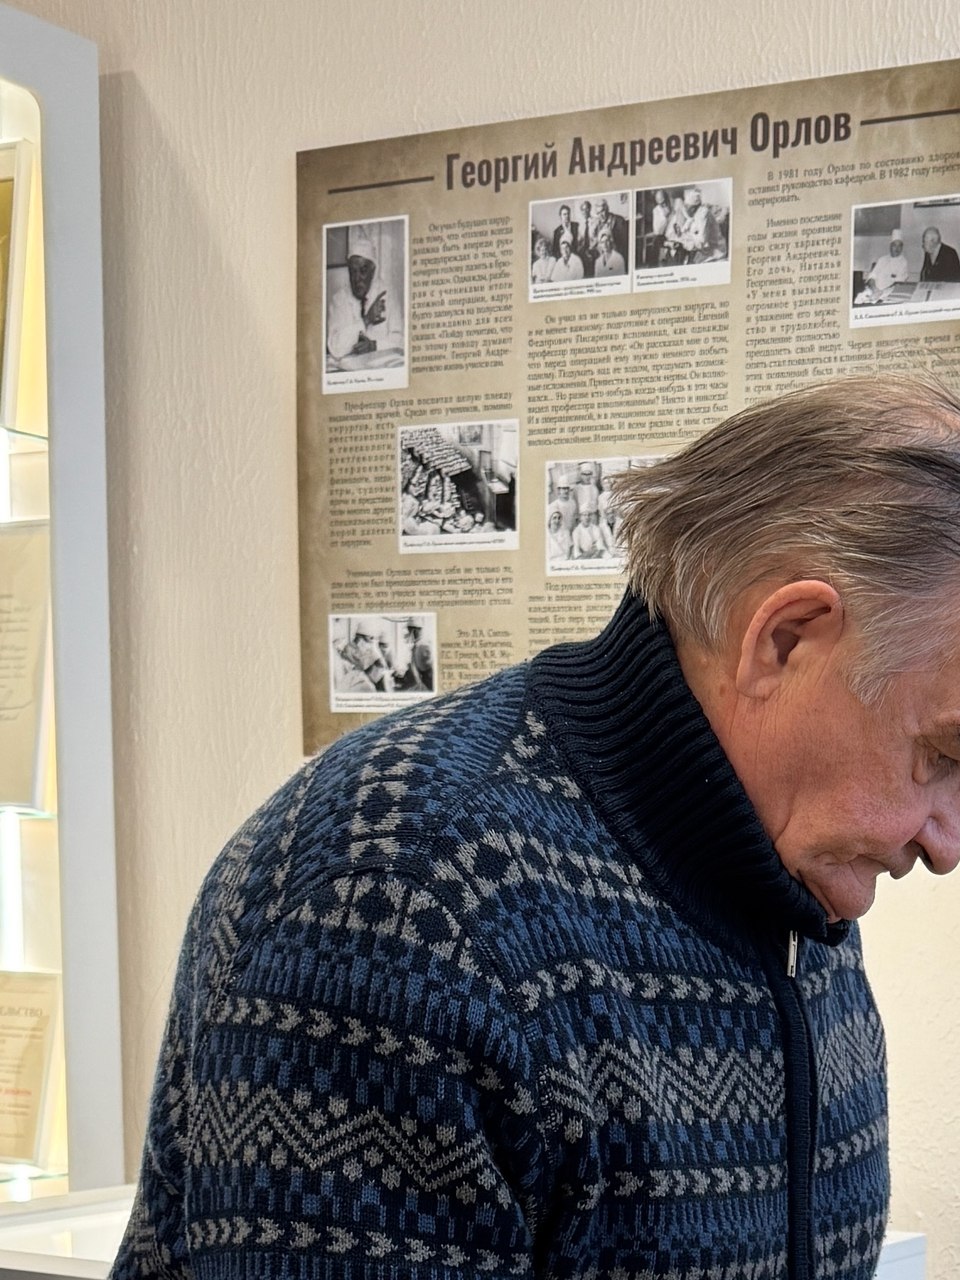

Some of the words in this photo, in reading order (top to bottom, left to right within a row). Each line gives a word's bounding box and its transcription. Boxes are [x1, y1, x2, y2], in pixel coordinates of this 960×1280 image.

[446, 142, 557, 193] Георгий
[568, 127, 737, 178] Андреевич
[750, 112, 851, 159] Орлов
